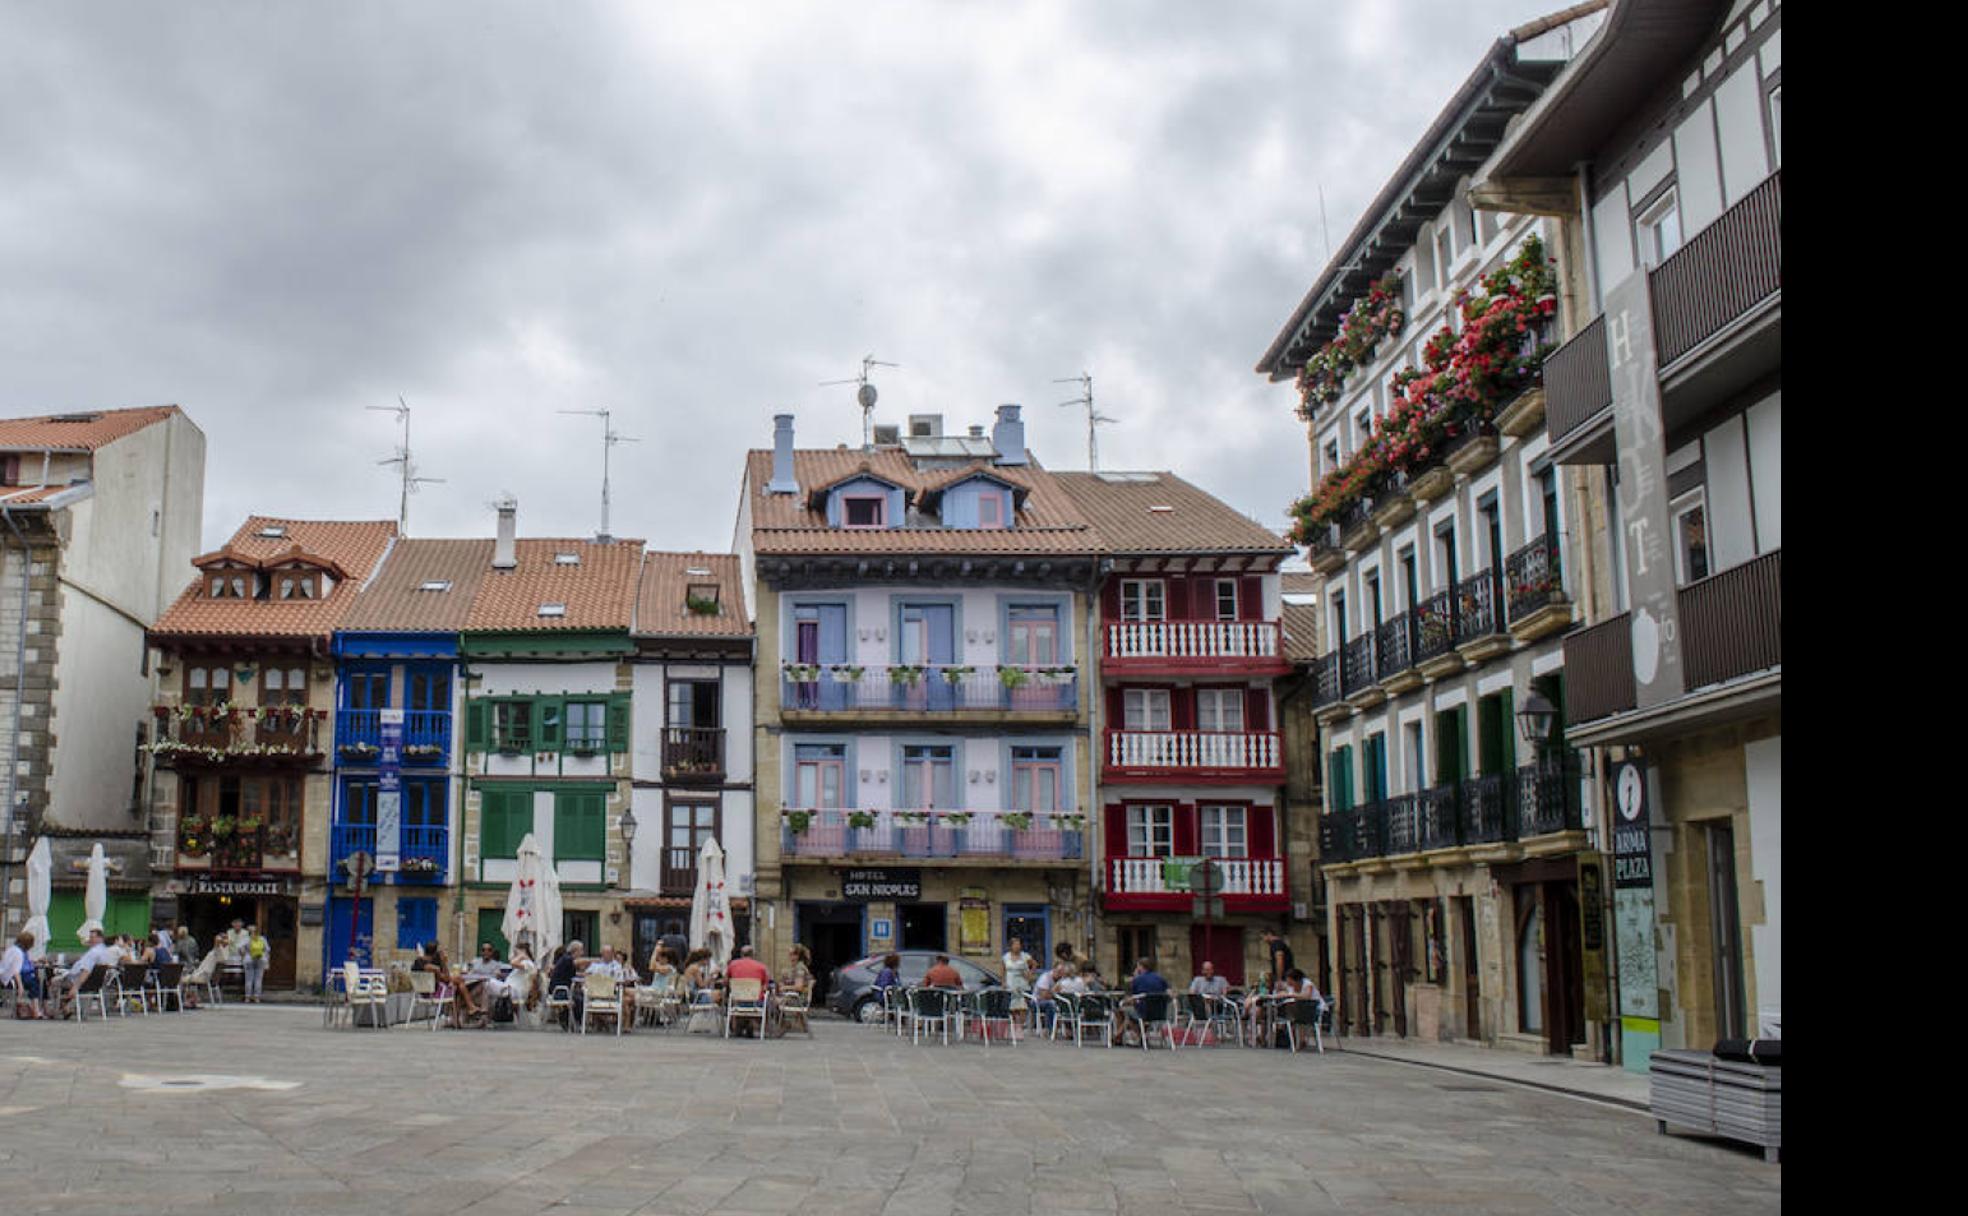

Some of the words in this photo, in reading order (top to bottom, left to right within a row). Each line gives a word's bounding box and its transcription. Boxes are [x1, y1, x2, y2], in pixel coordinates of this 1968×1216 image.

[1616, 830, 1646, 853] ARMA
[849, 871, 887, 881] HOTEL
[1616, 856, 1649, 880] PLAZA
[844, 883, 870, 896] SAN
